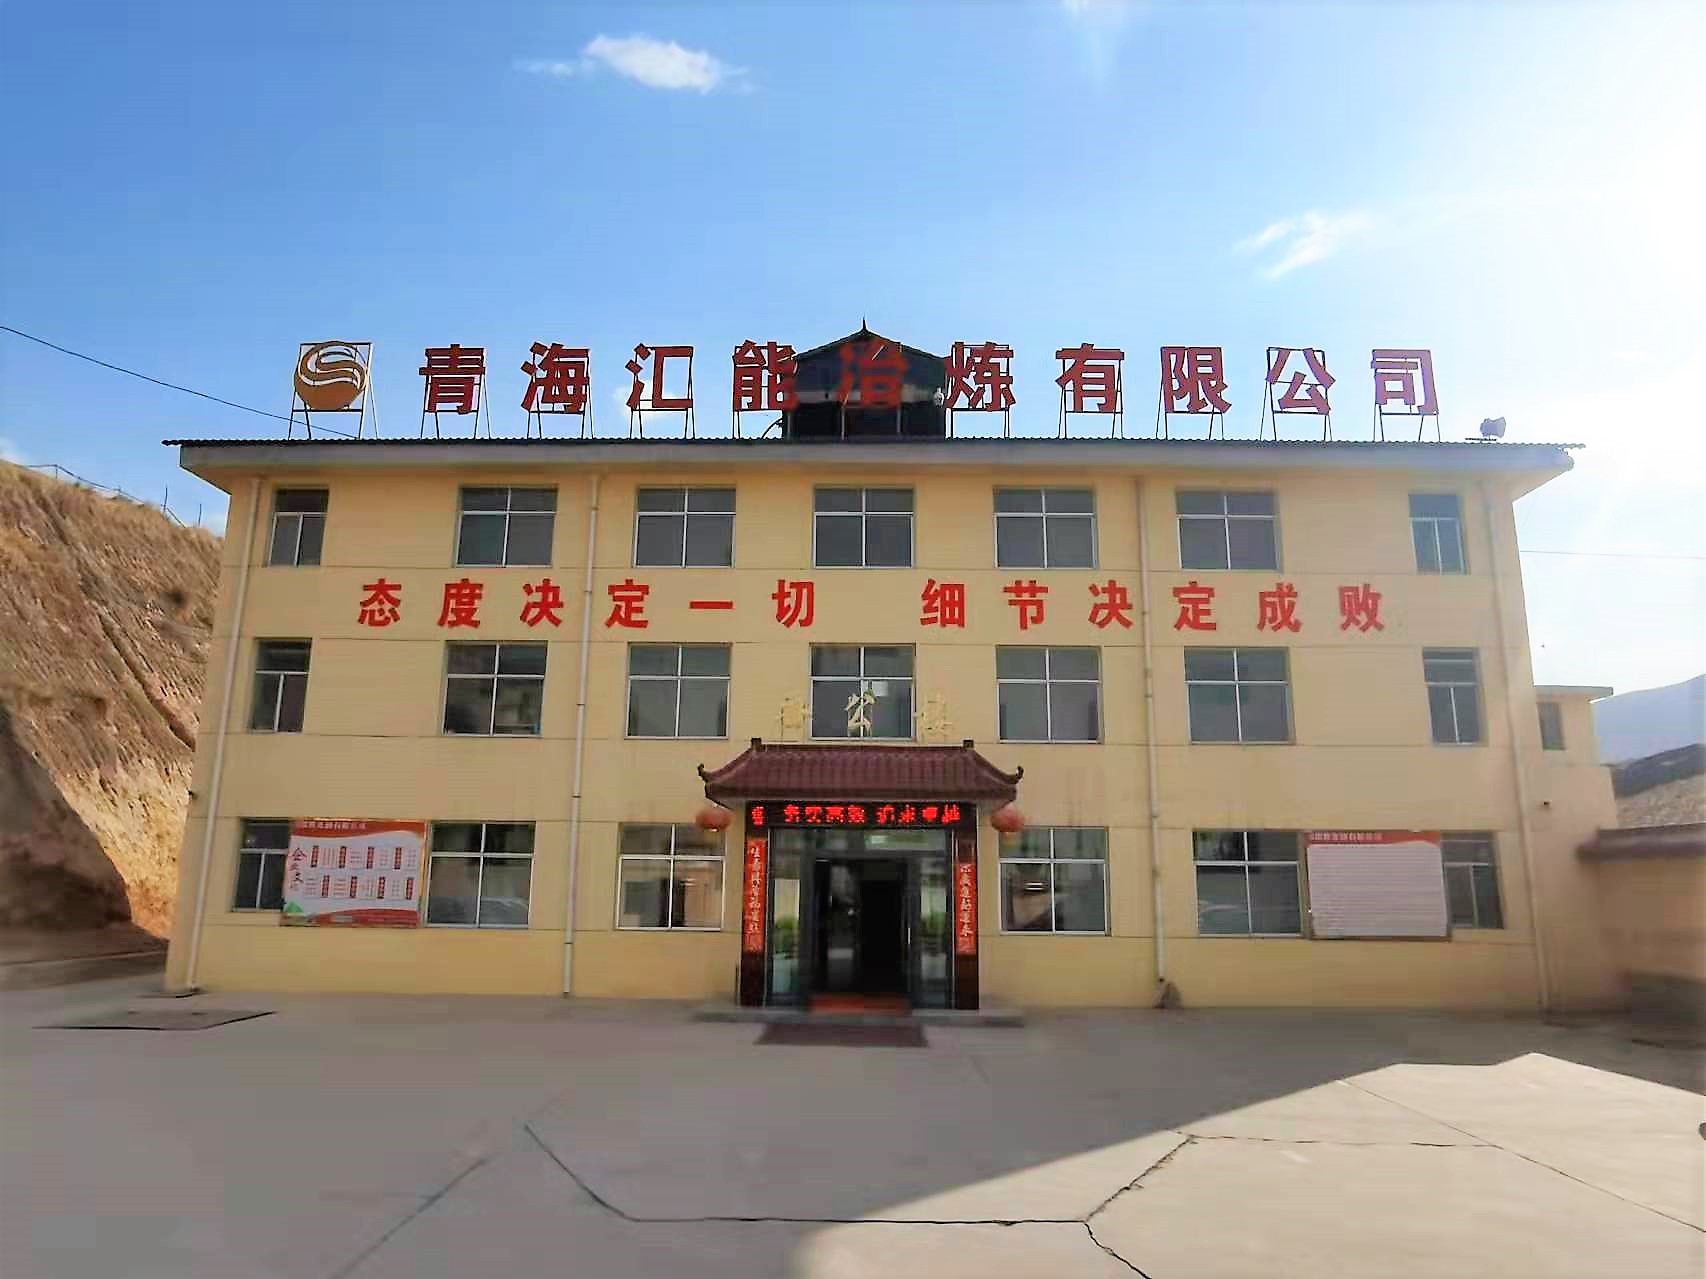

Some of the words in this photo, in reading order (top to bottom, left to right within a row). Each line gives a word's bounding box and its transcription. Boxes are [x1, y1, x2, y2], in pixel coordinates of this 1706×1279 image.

[419, 340, 1439, 415] 青海汇能冶炼有限公司
[358, 578, 816, 628] 态度决定一切
[920, 579, 1385, 633] 细节决定成败
